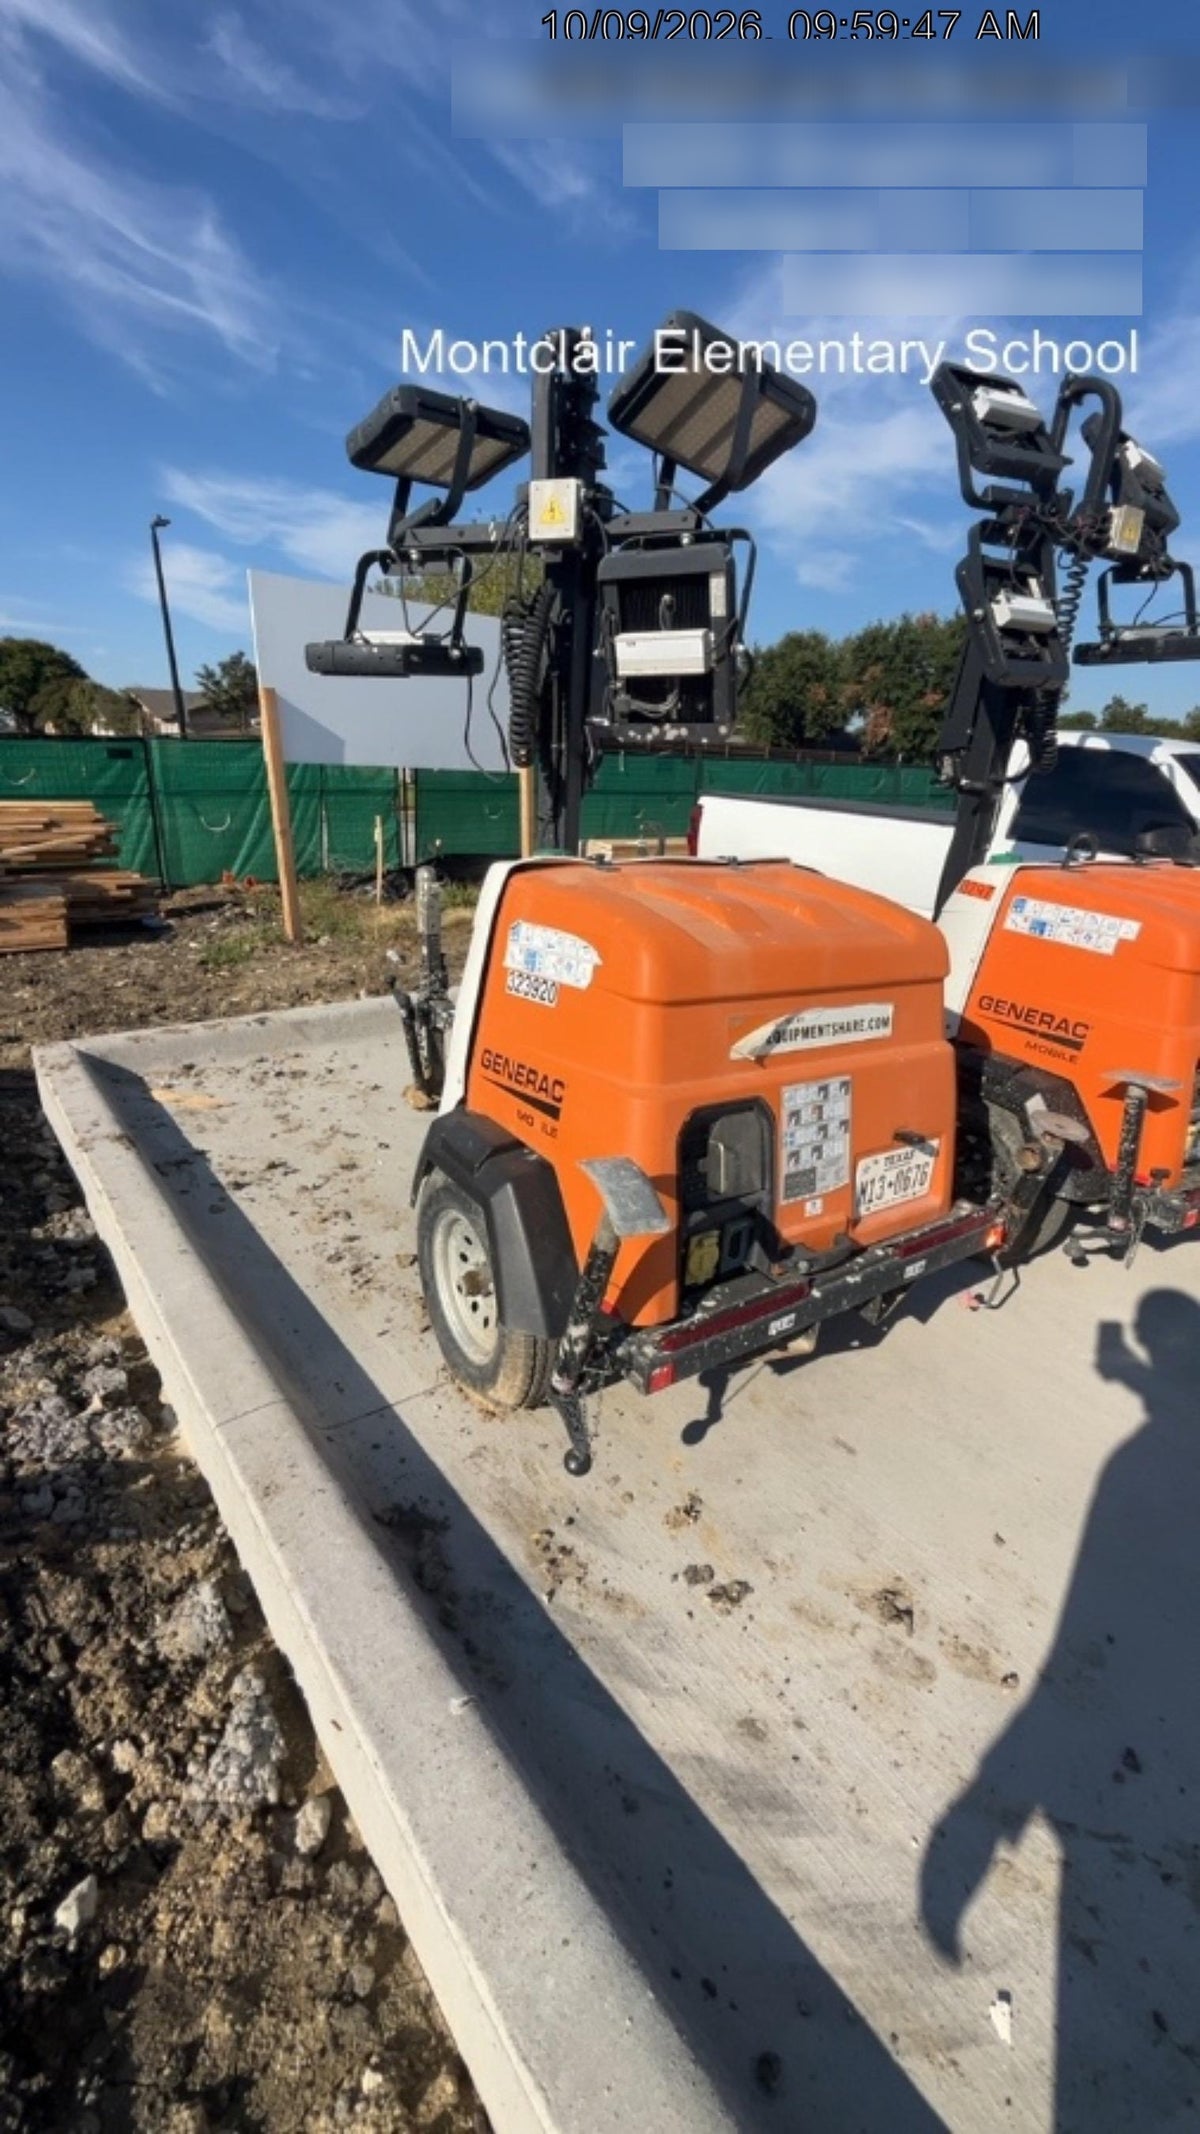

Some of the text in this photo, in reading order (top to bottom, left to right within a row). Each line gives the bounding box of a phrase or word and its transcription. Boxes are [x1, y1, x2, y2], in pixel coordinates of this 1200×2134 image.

[507, 969, 556, 1004] 323920
[979, 995, 1089, 1039] GENERAC
[481, 1048, 565, 1103] GENERAC
[516, 1109, 558, 1138] MOILE
